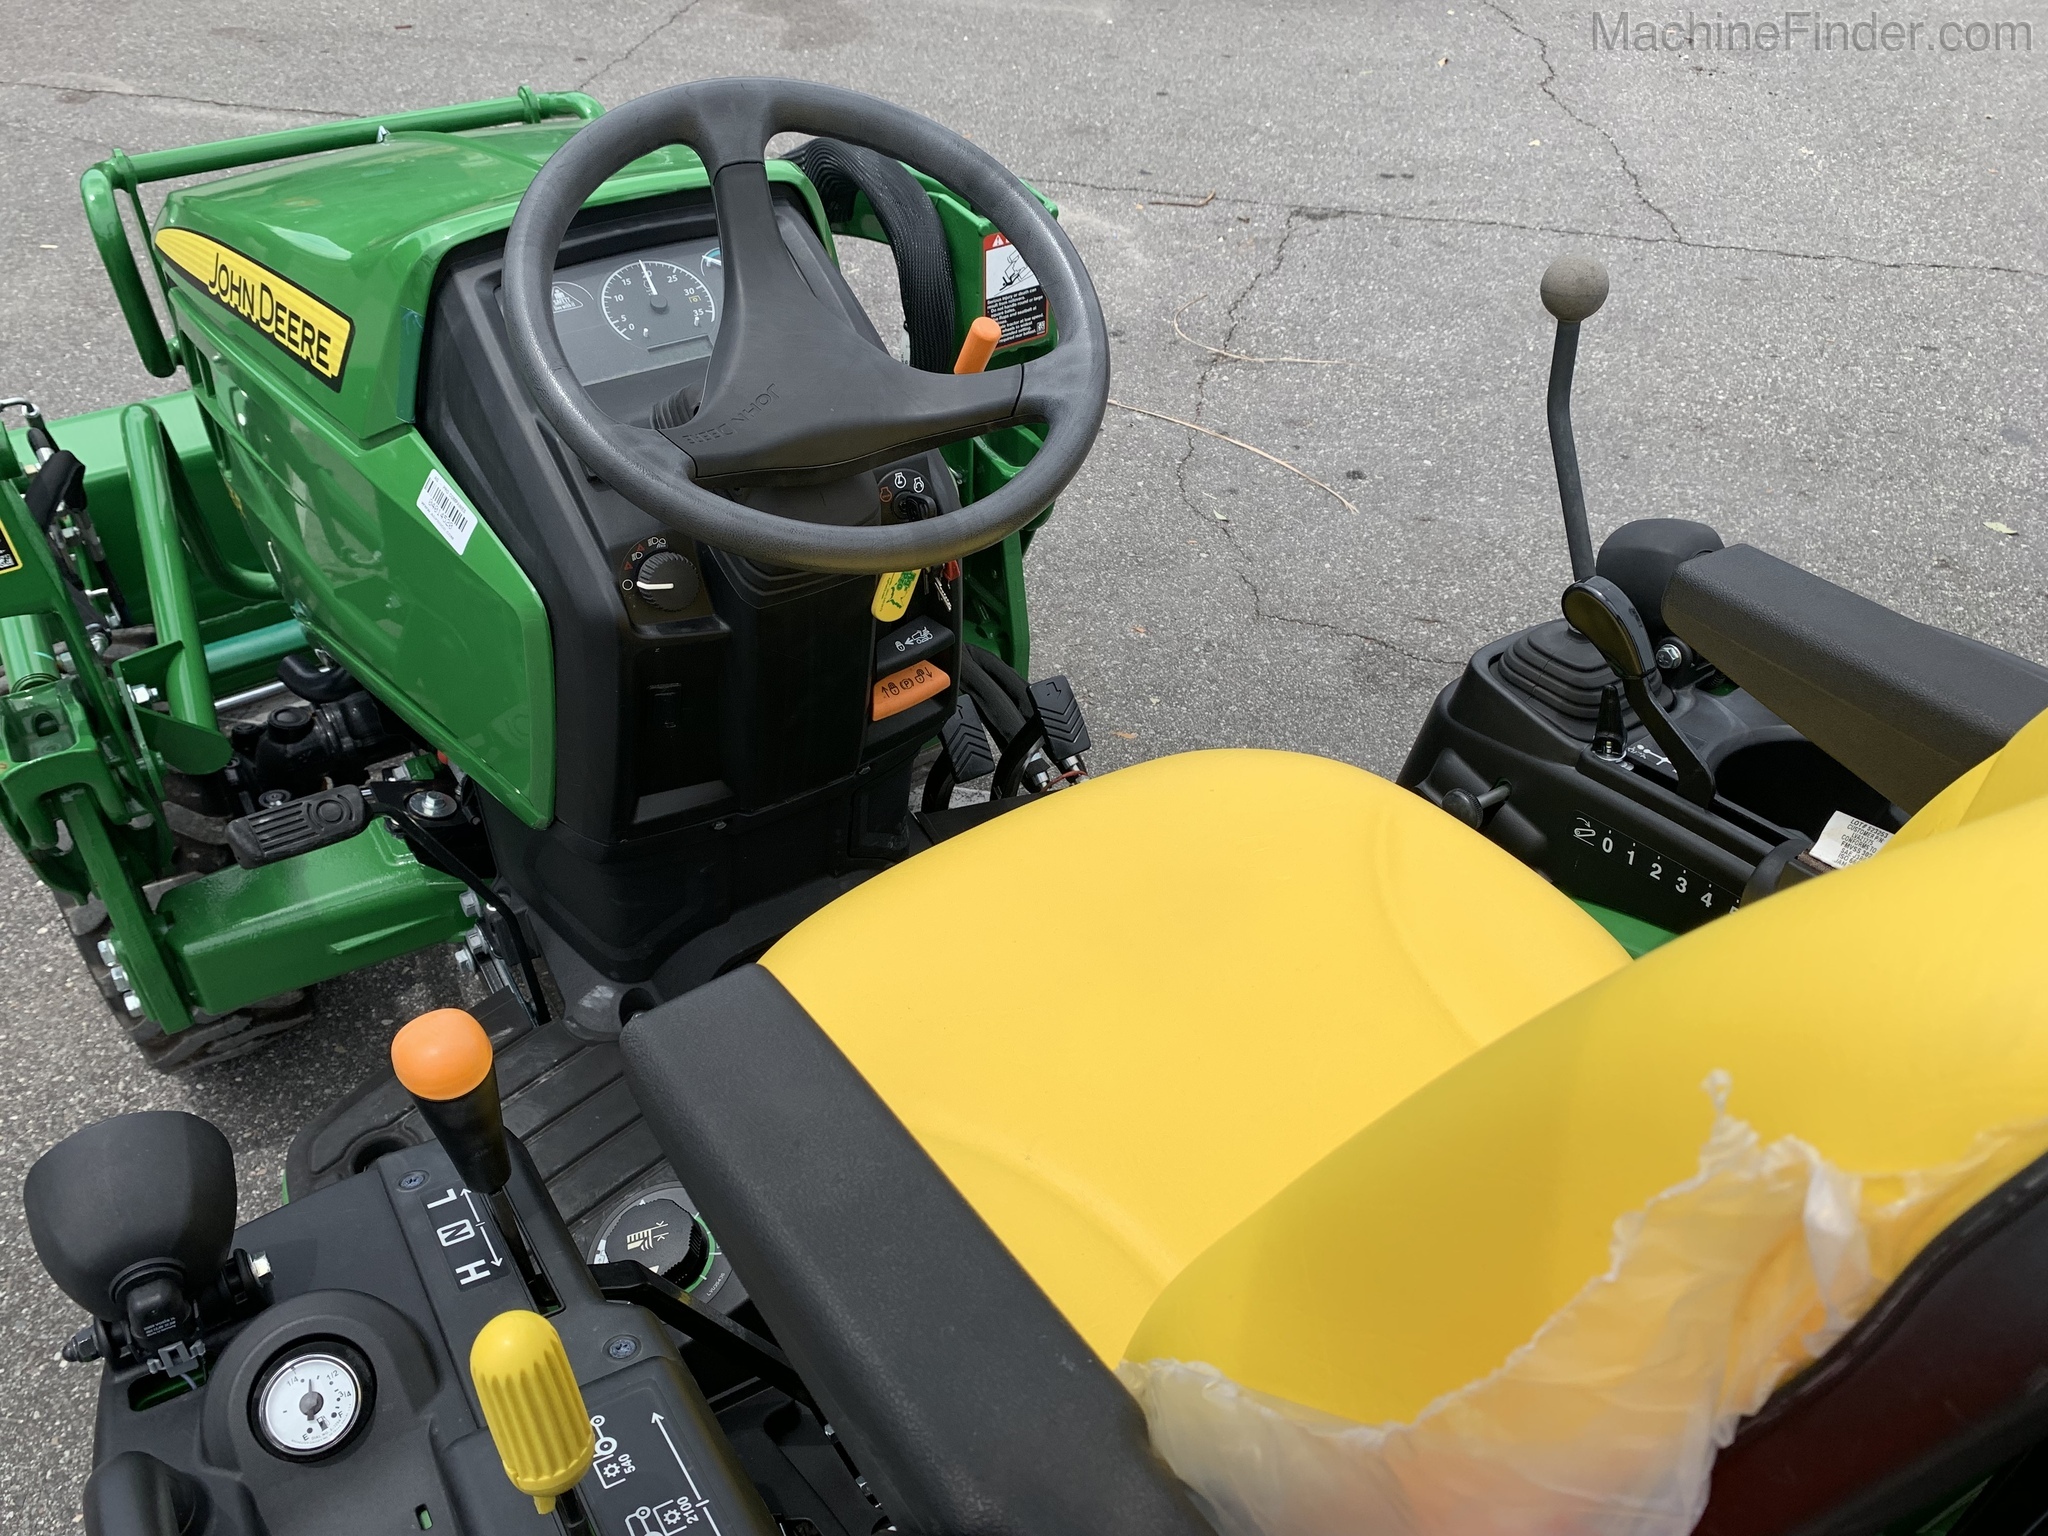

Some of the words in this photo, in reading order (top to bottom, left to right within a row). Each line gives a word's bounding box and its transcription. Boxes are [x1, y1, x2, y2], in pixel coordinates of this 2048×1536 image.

[622, 278, 632, 286] 15
[667, 275, 678, 283] 25
[684, 288, 695, 296] 30
[208, 252, 255, 317] JOHN
[260, 281, 331, 371] DEERE
[693, 309, 704, 317] 35
[731, 383, 780, 422] JOHN
[1850, 818, 1868, 829] LOT#
[1846, 824, 1874, 840] CUSTOMER
[1840, 841, 1862, 853] FMVSS
[1841, 834, 1870, 851] CONFORMS
[1838, 854, 1849, 862] ISO
[1841, 848, 1852, 856] SAE
[1602, 837, 1613, 853] 0
[1627, 850, 1635, 866] 1
[1650, 863, 1662, 880] 2
[1675, 877, 1688, 894] 3
[1700, 892, 1713, 908] 4
[427, 1188, 457, 1209] L
[439, 1221, 473, 1245] N
[455, 1259, 491, 1285] H
[327, 1370, 339, 1380] 1/2
[287, 1376, 299, 1387] 1/4
[302, 1433, 309, 1441] E
[618, 1453, 636, 1474] 540
[676, 1496, 699, 1524] 2100
